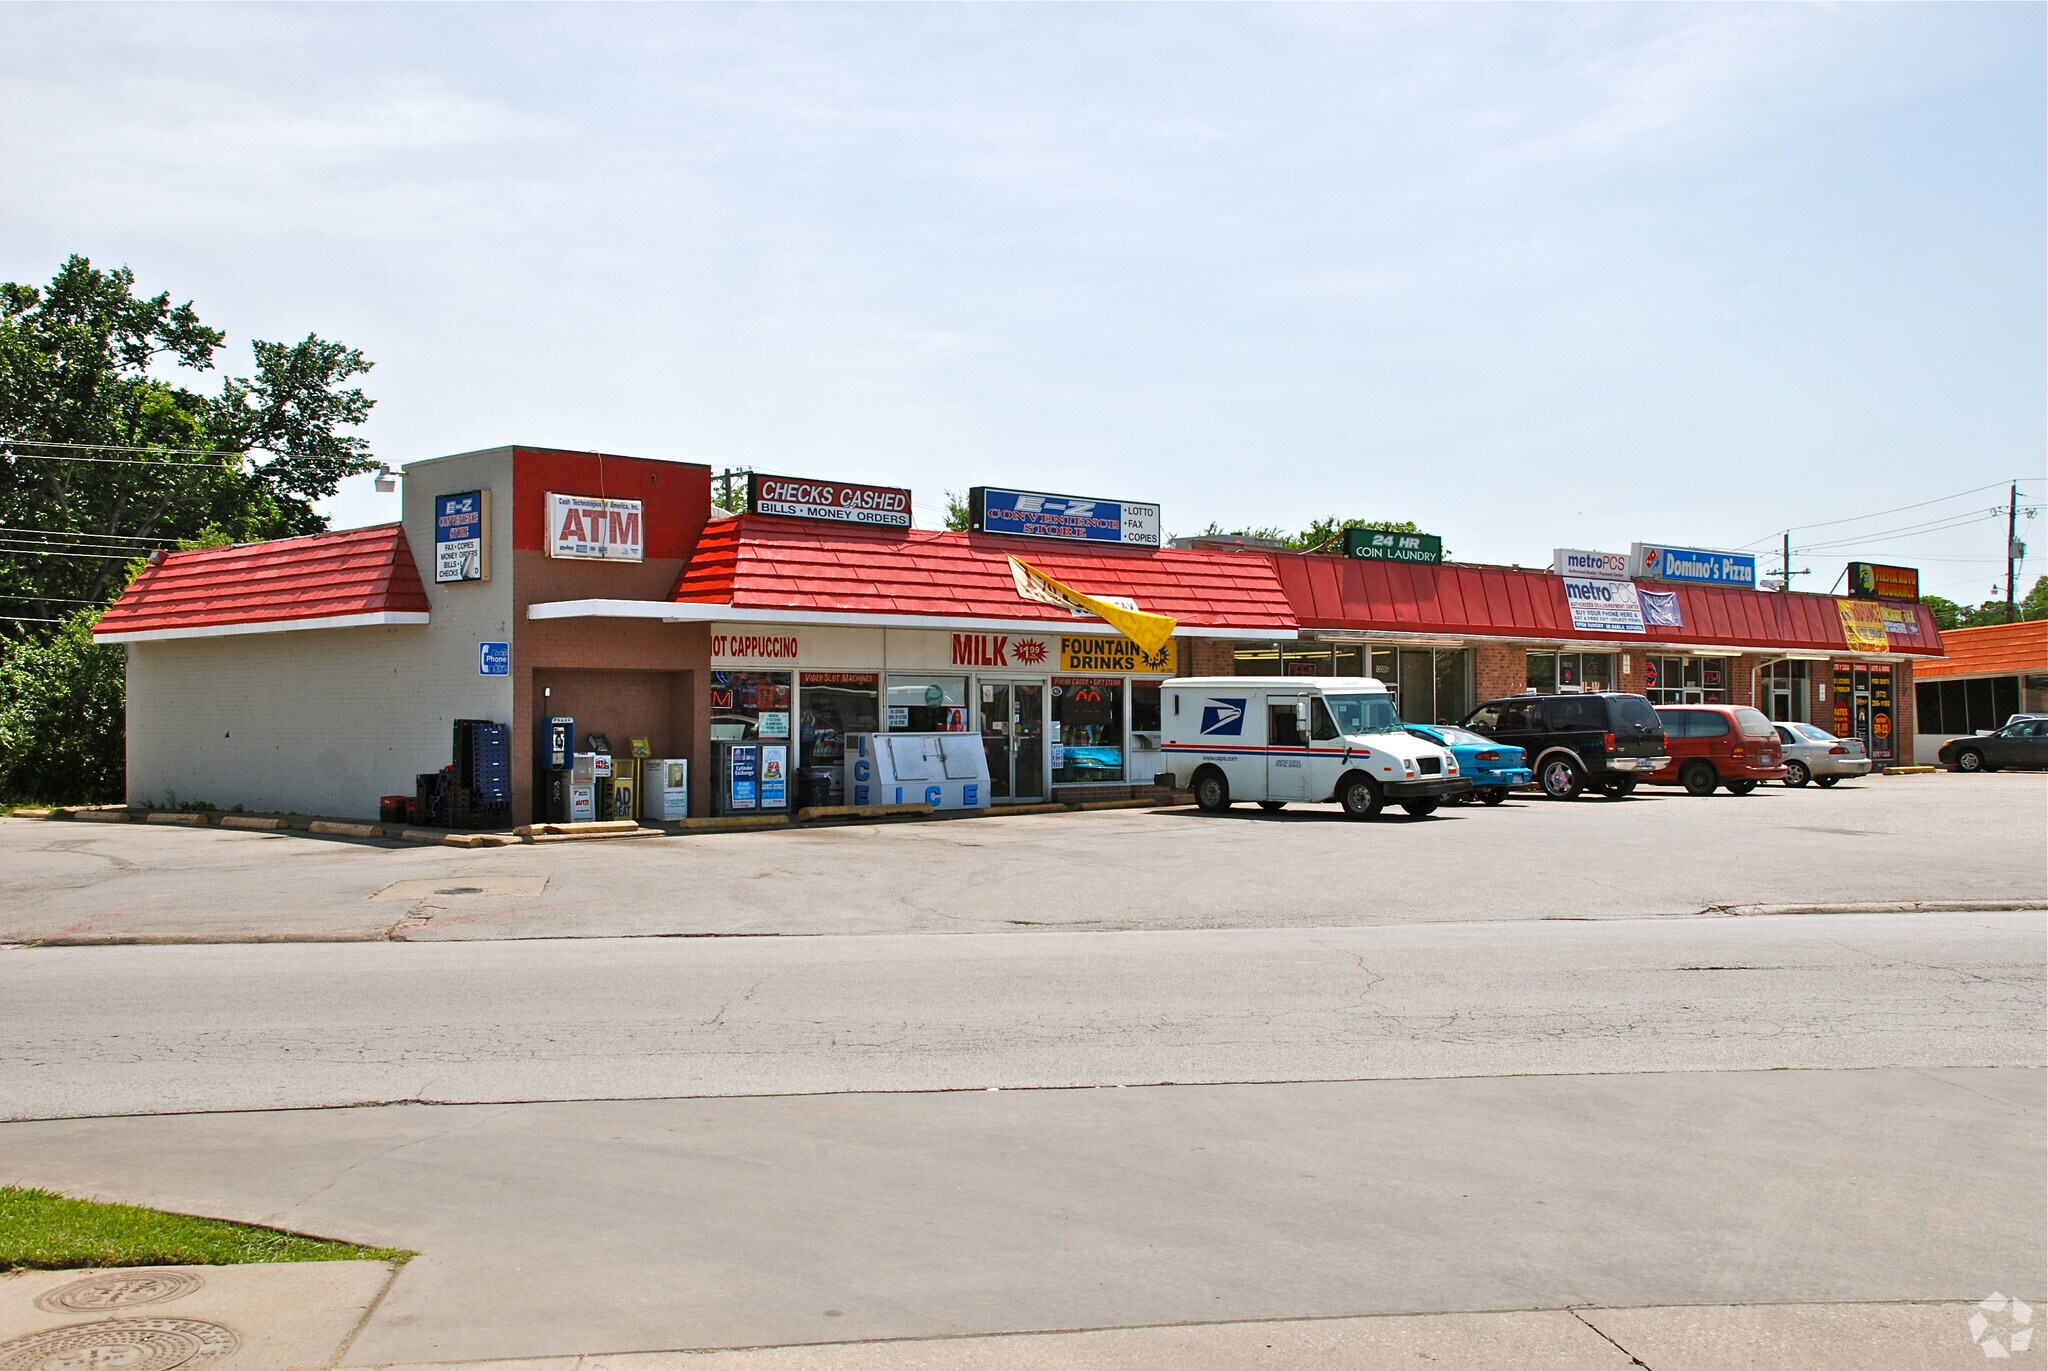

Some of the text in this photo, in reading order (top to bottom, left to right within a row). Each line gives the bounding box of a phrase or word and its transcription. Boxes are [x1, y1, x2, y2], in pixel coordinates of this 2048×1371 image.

[762, 481, 906, 511] CHECKS CASHED
[446, 498, 473, 515] E-Z
[573, 499, 601, 509] Technologies
[610, 501, 630, 511] America,
[1014, 495, 1096, 518] E-Z
[1128, 507, 1153, 517] LOTTO
[439, 512, 478, 527] CONVENIENCE
[761, 503, 906, 524] BILLS MONEY ORDERS
[988, 508, 1119, 530] CONVENIENCE
[559, 508, 639, 545] ATM
[1023, 524, 1087, 538] STORE
[1128, 520, 1143, 529] FAX
[449, 526, 469, 539] STORE
[1128, 533, 1157, 543] COPIES
[458, 541, 474, 550] COPIES
[1372, 534, 1420, 549] 24 HR
[441, 552, 457, 560] MONEY
[1356, 547, 1436, 561] COIN LAUNDRY
[444, 561, 456, 569] BILLS
[1568, 554, 1625, 571] metroPCS
[1666, 552, 1752, 582] Domino's Pizza
[439, 569, 458, 577] CHECKS
[1875, 571, 1917, 585] FIESTA AUTO
[1566, 581, 1638, 604] metroPCS
[1878, 586, 1915, 598] INSURANCE
[730, 636, 798, 658] CAPPUCCINO
[953, 634, 1008, 666] MILK
[1062, 638, 1140, 656] FOUNTAIN
[1070, 656, 1135, 670] DRINKS
[805, 673, 873, 682] VIDEO SLOT MACHINES
[1072, 678, 1089, 686] CARDS
[854, 736, 870, 806] ICE
[605, 783, 614, 819] BEAT
[615, 787, 632, 806] AD
[614, 806, 631, 818] BEAT
